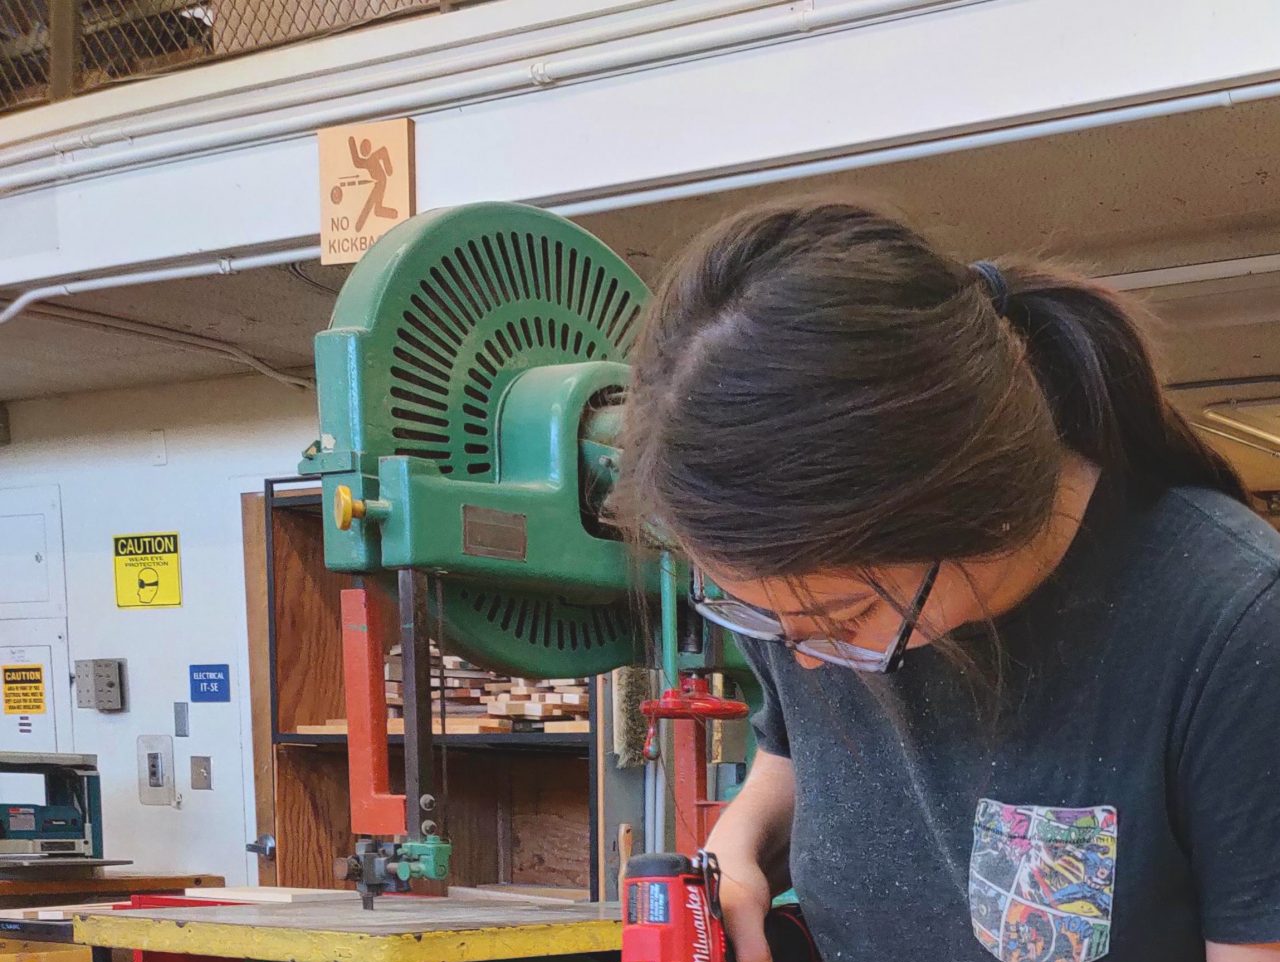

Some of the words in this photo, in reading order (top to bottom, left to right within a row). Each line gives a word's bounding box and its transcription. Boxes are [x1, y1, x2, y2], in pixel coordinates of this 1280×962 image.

[331, 216, 350, 232] NO
[328, 235, 376, 254] KICKBA
[118, 536, 175, 555] CAUTION
[5, 671, 41, 681] CAUTION
[193, 672, 224, 680] ELECTRICAL
